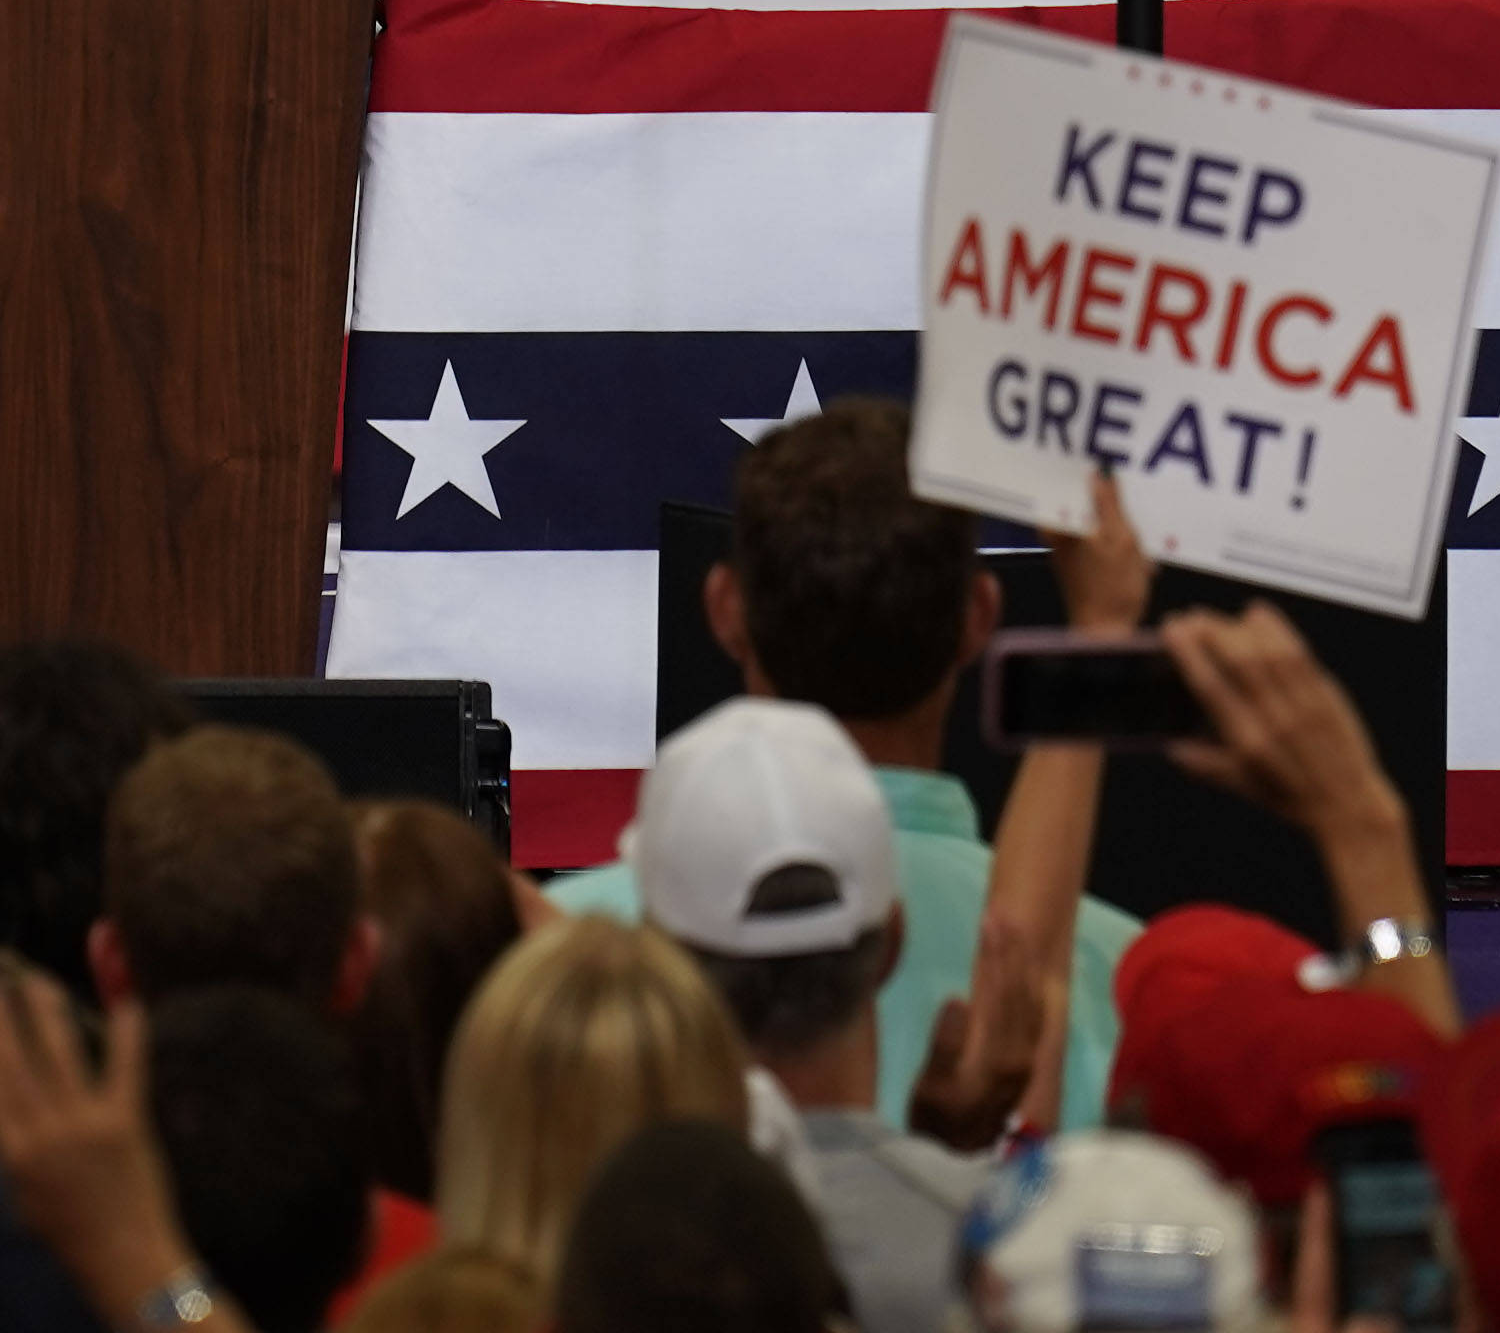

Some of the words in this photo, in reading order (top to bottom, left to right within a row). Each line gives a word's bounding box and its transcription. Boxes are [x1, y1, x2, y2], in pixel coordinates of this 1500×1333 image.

[1052, 121, 1306, 245] KEEP
[936, 215, 1419, 417] AMERICA
[985, 357, 1320, 512] GREAT!
